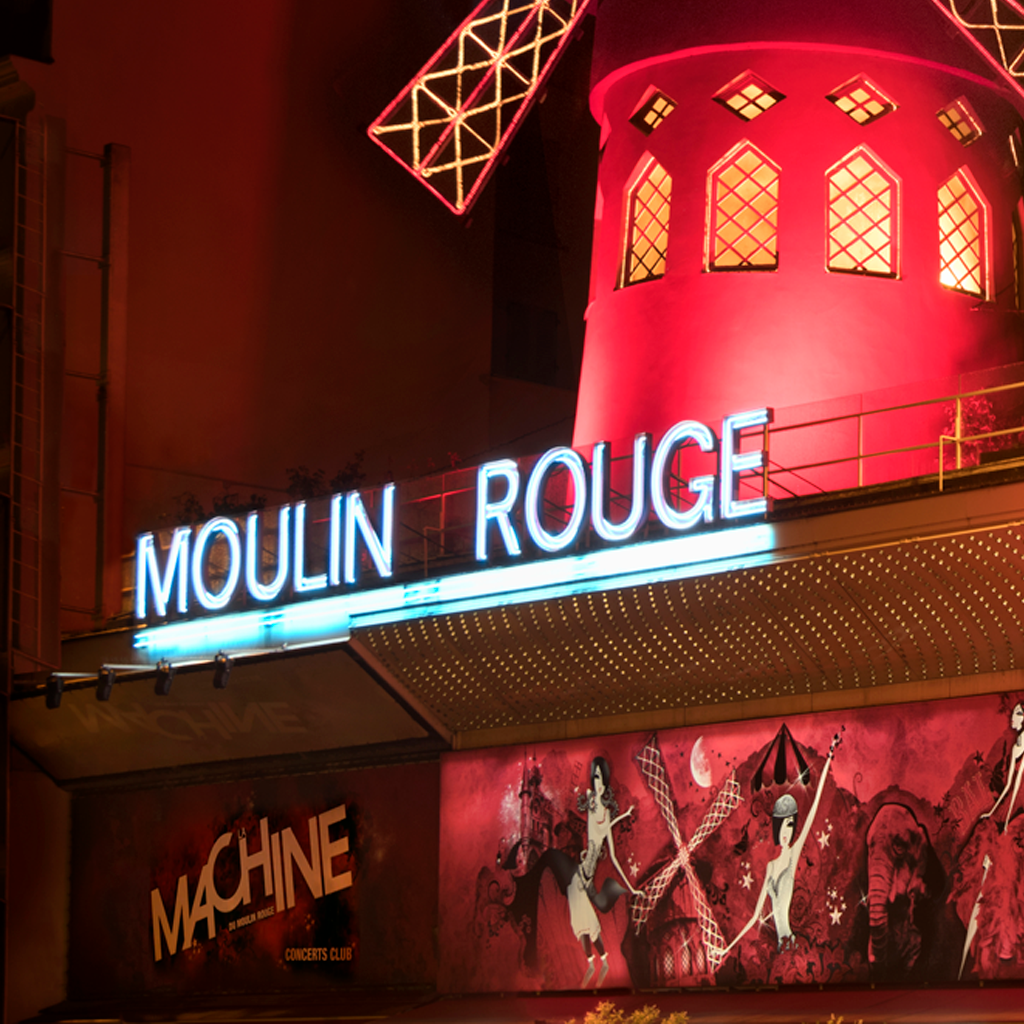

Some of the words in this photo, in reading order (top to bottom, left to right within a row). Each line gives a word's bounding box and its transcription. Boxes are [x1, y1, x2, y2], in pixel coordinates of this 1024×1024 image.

[134, 483, 396, 619] MOULIN
[474, 407, 773, 561] ROUGE
[150, 803, 353, 963] MACHINE
[236, 912, 256, 929] MOULIN
[256, 905, 275, 920] ROUGE
[284, 947, 328, 962] CONCERTS
[329, 946, 353, 961] CLUB
